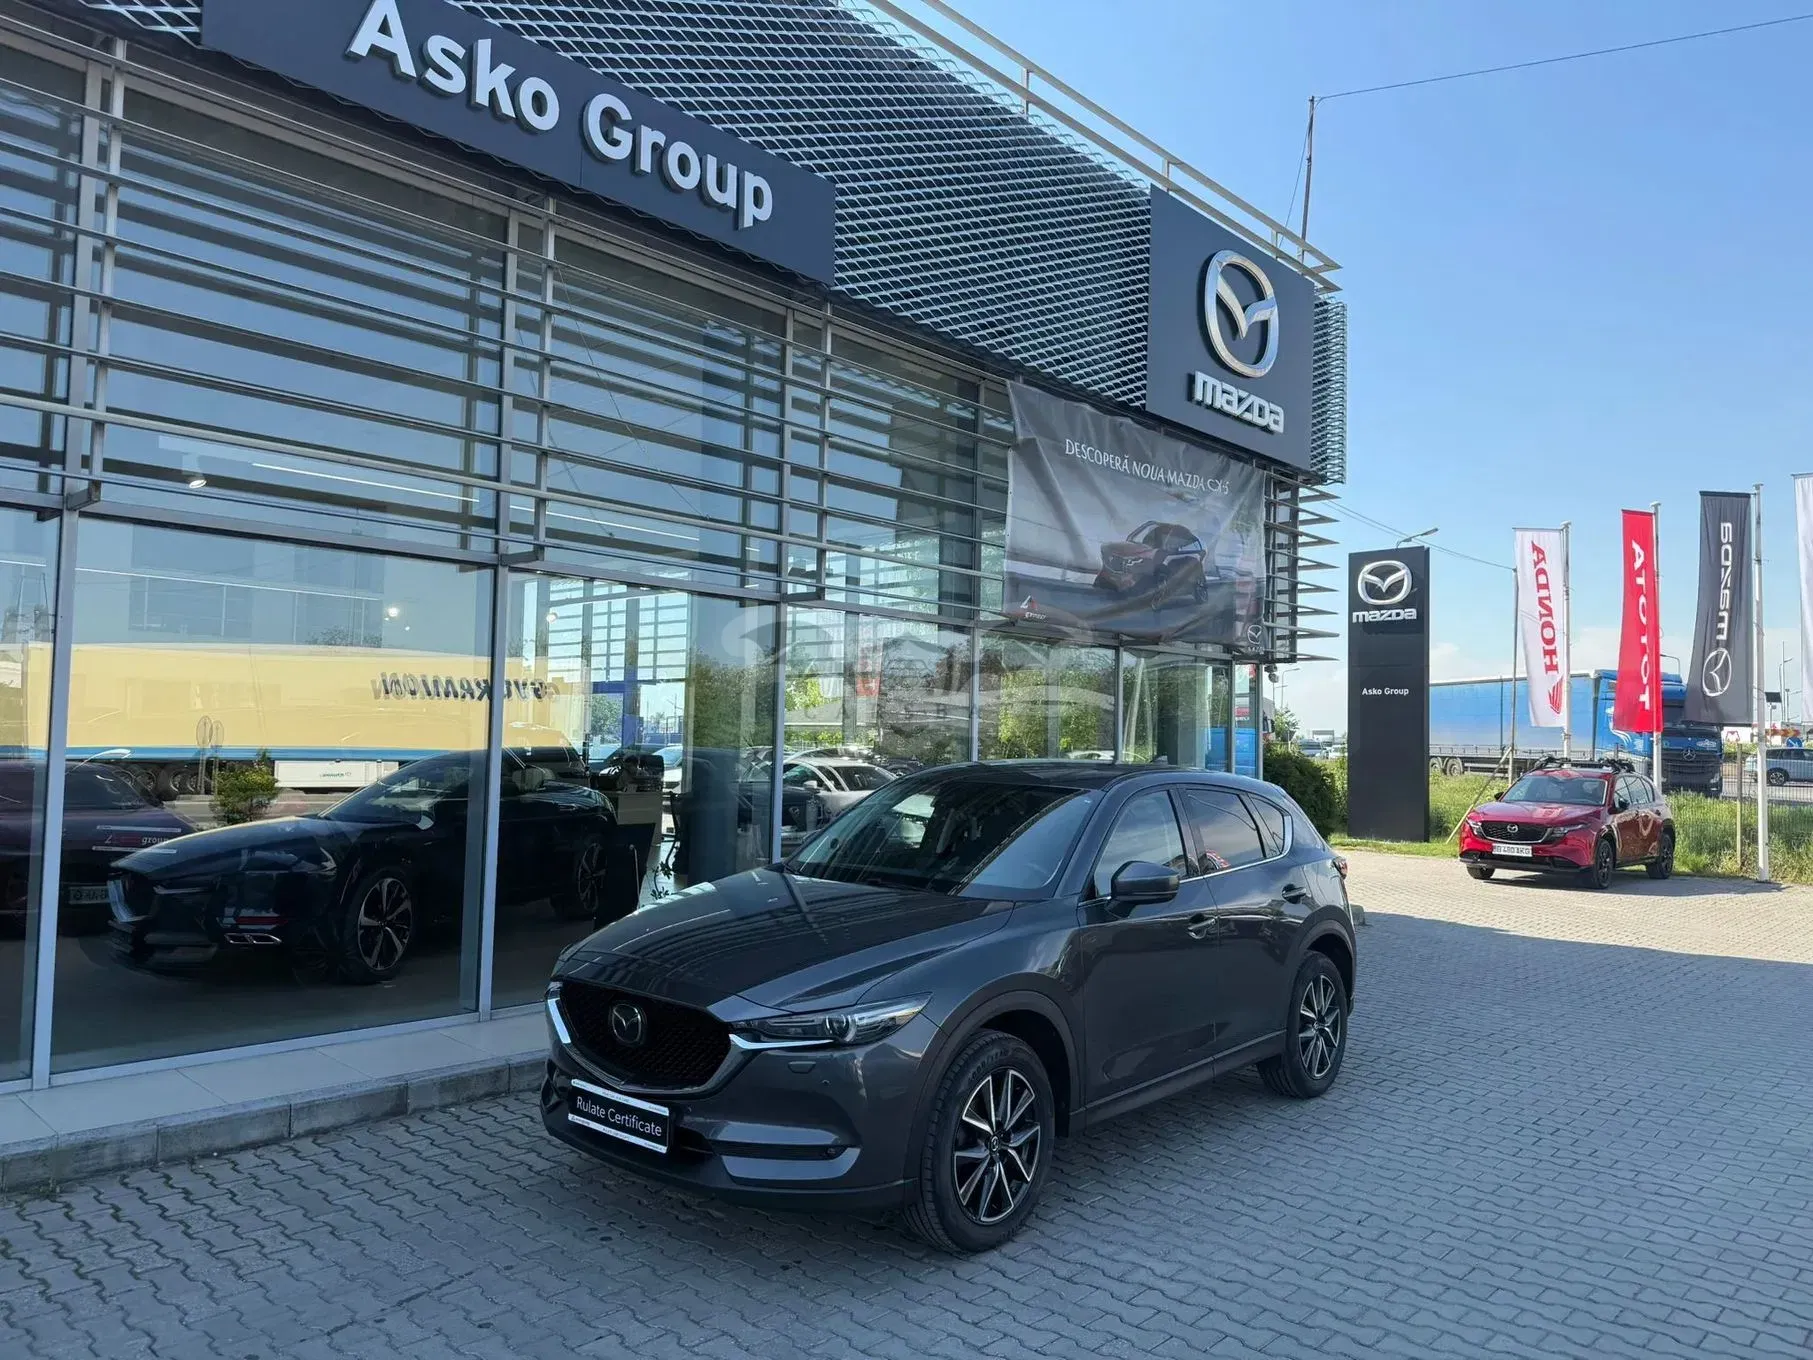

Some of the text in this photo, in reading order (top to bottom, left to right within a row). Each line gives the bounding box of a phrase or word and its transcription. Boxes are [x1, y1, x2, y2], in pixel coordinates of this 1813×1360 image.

[345, 0, 773, 231] Asko Group
[1194, 370, 1284, 434] mazda
[1065, 438, 1131, 474] DESCOPERĂ
[1132, 461, 1165, 482] NOUA
[1166, 469, 1205, 491] MAZDA
[1352, 608, 1417, 623] mazda
[1361, 687, 1410, 696] Asko Group
[576, 1096, 606, 1119] Rulate
[607, 1108, 662, 1137] Certificate
